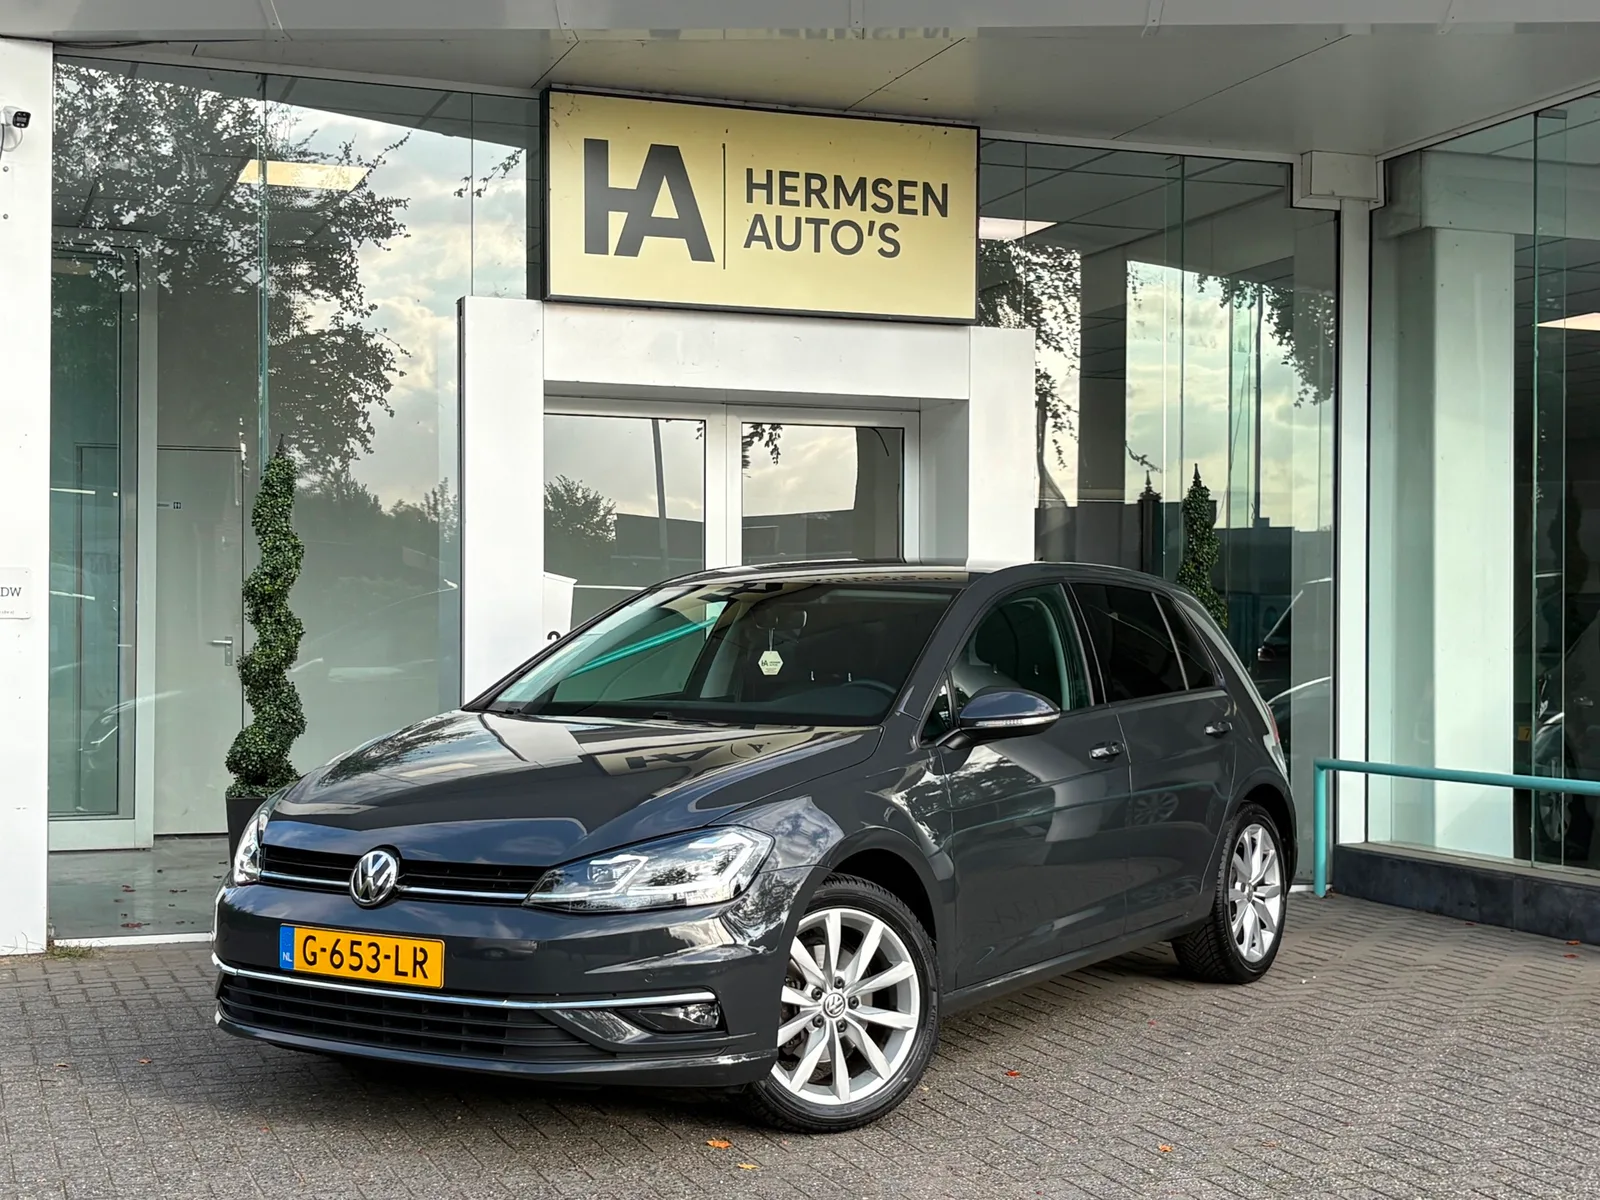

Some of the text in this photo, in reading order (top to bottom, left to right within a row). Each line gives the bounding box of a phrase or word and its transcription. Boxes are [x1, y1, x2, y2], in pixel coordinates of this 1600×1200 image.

[583, 138, 715, 262] HA
[745, 168, 948, 217] HERMSEN
[743, 213, 901, 259] AUTO'S
[282, 951, 293, 963] NL
[303, 935, 428, 979] G-653-LR
